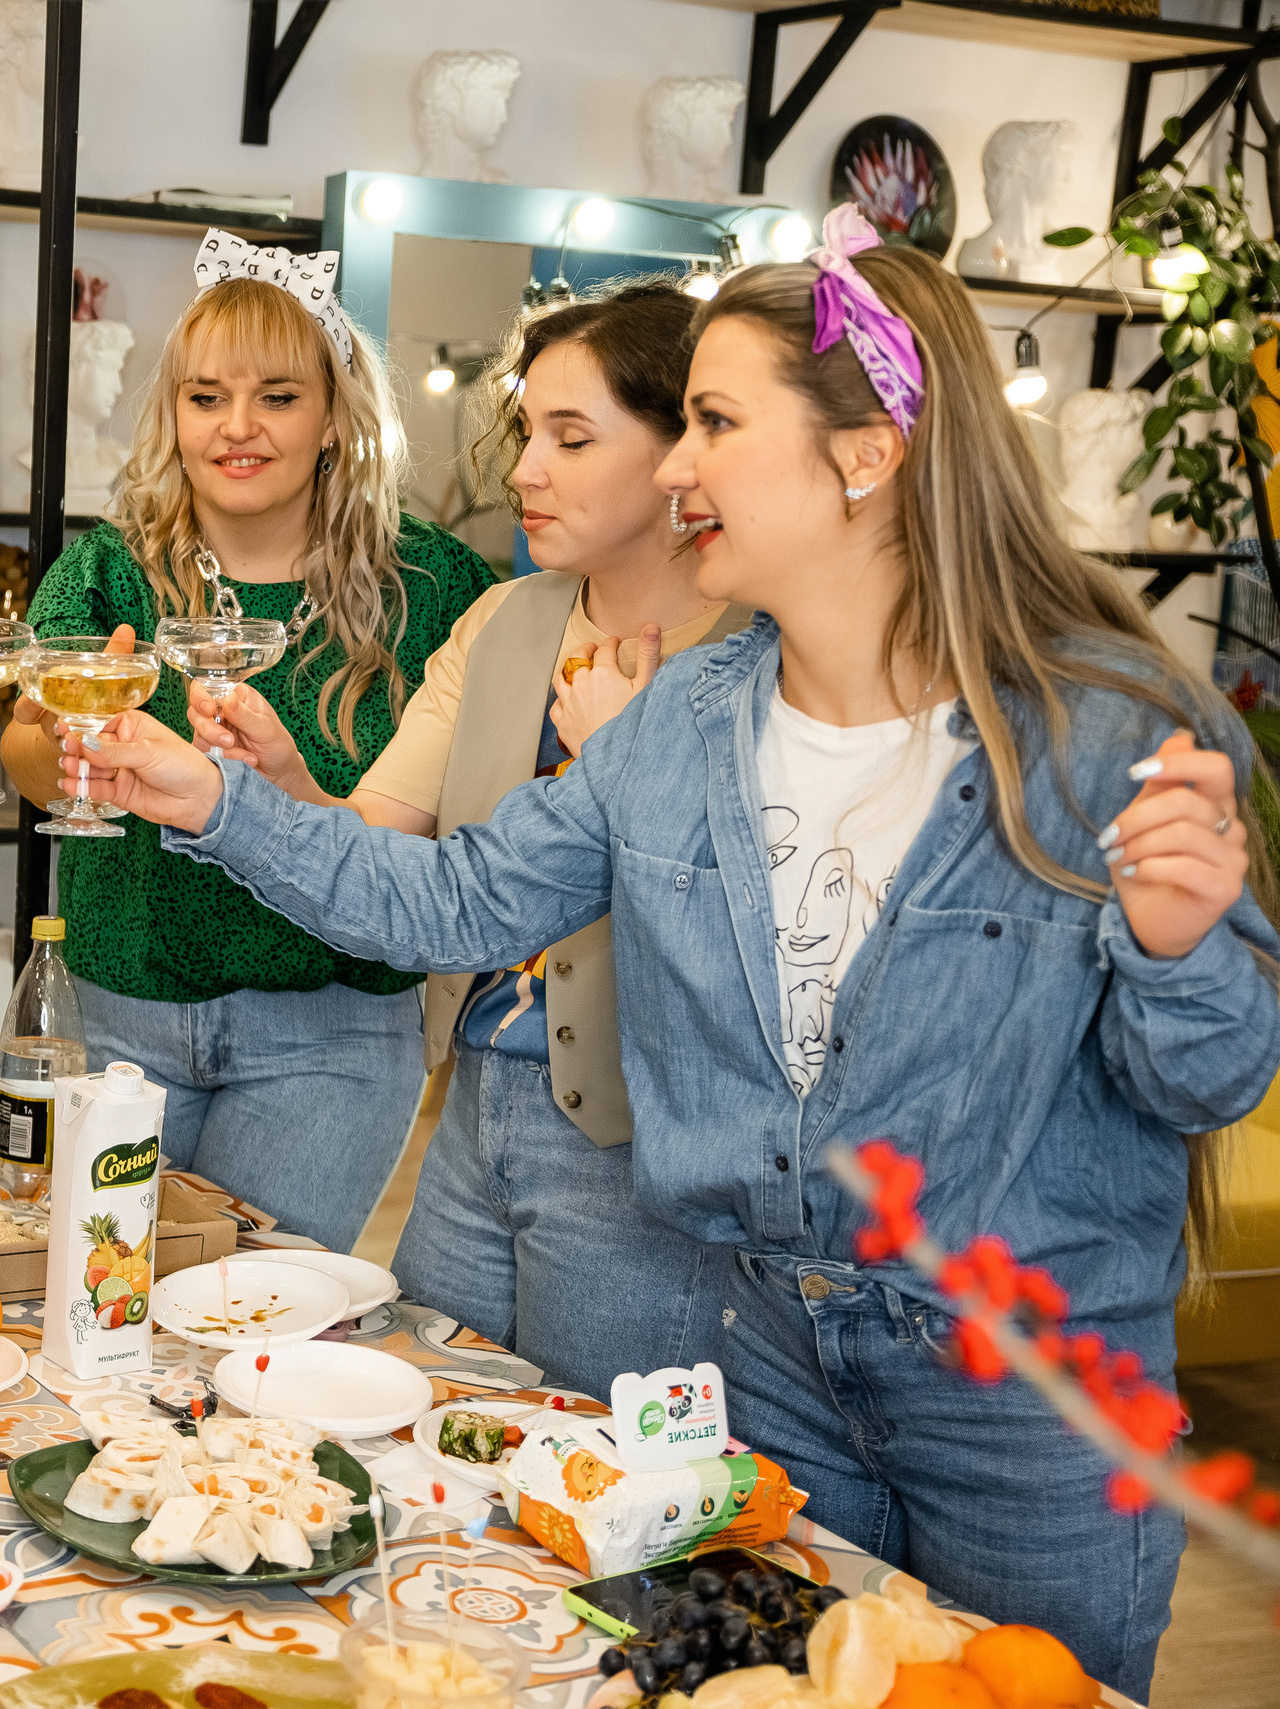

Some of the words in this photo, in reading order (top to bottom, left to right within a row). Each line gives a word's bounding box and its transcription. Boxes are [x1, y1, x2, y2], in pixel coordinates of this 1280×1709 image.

[97, 1142, 158, 1183] Сочный
[97, 1350, 140, 1363] МУЛЬТИФРУКТ
[667, 1423, 717, 1444] ДЕТСКИЕ
